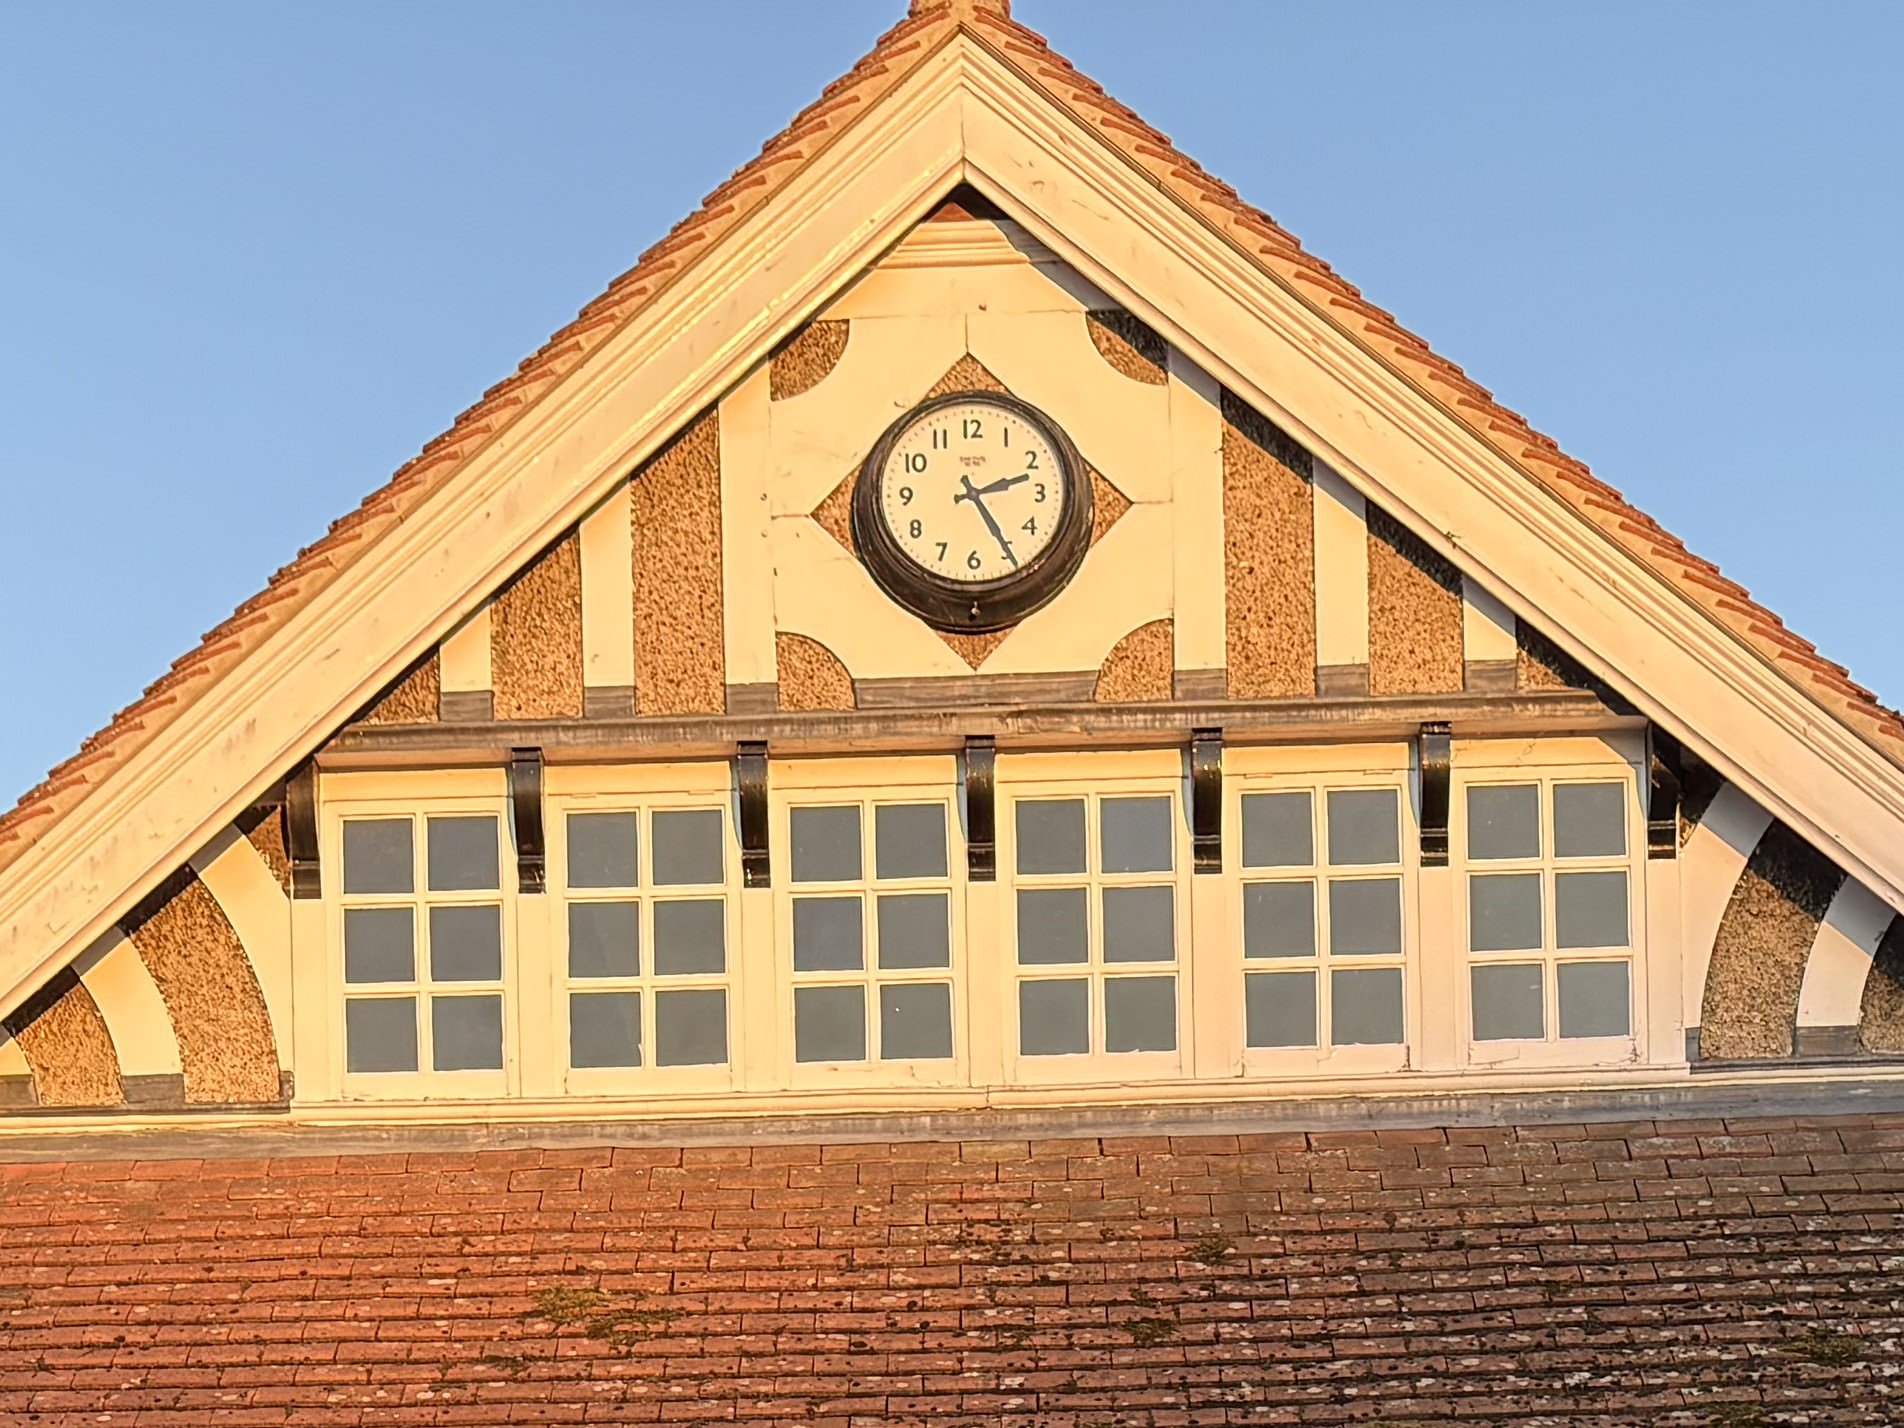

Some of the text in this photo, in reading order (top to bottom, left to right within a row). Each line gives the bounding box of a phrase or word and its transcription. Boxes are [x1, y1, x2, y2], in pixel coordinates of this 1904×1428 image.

[932, 428, 948, 449] 11
[962, 418, 984, 440] 12
[904, 453, 927, 473] 10
[1024, 450, 1039, 470] 2
[899, 486, 913, 506] 9
[1034, 483, 1046, 503] 3
[909, 519, 922, 539] 8
[1021, 516, 1038, 535] 4
[935, 542, 948, 562] 7
[967, 550, 981, 570] 6
